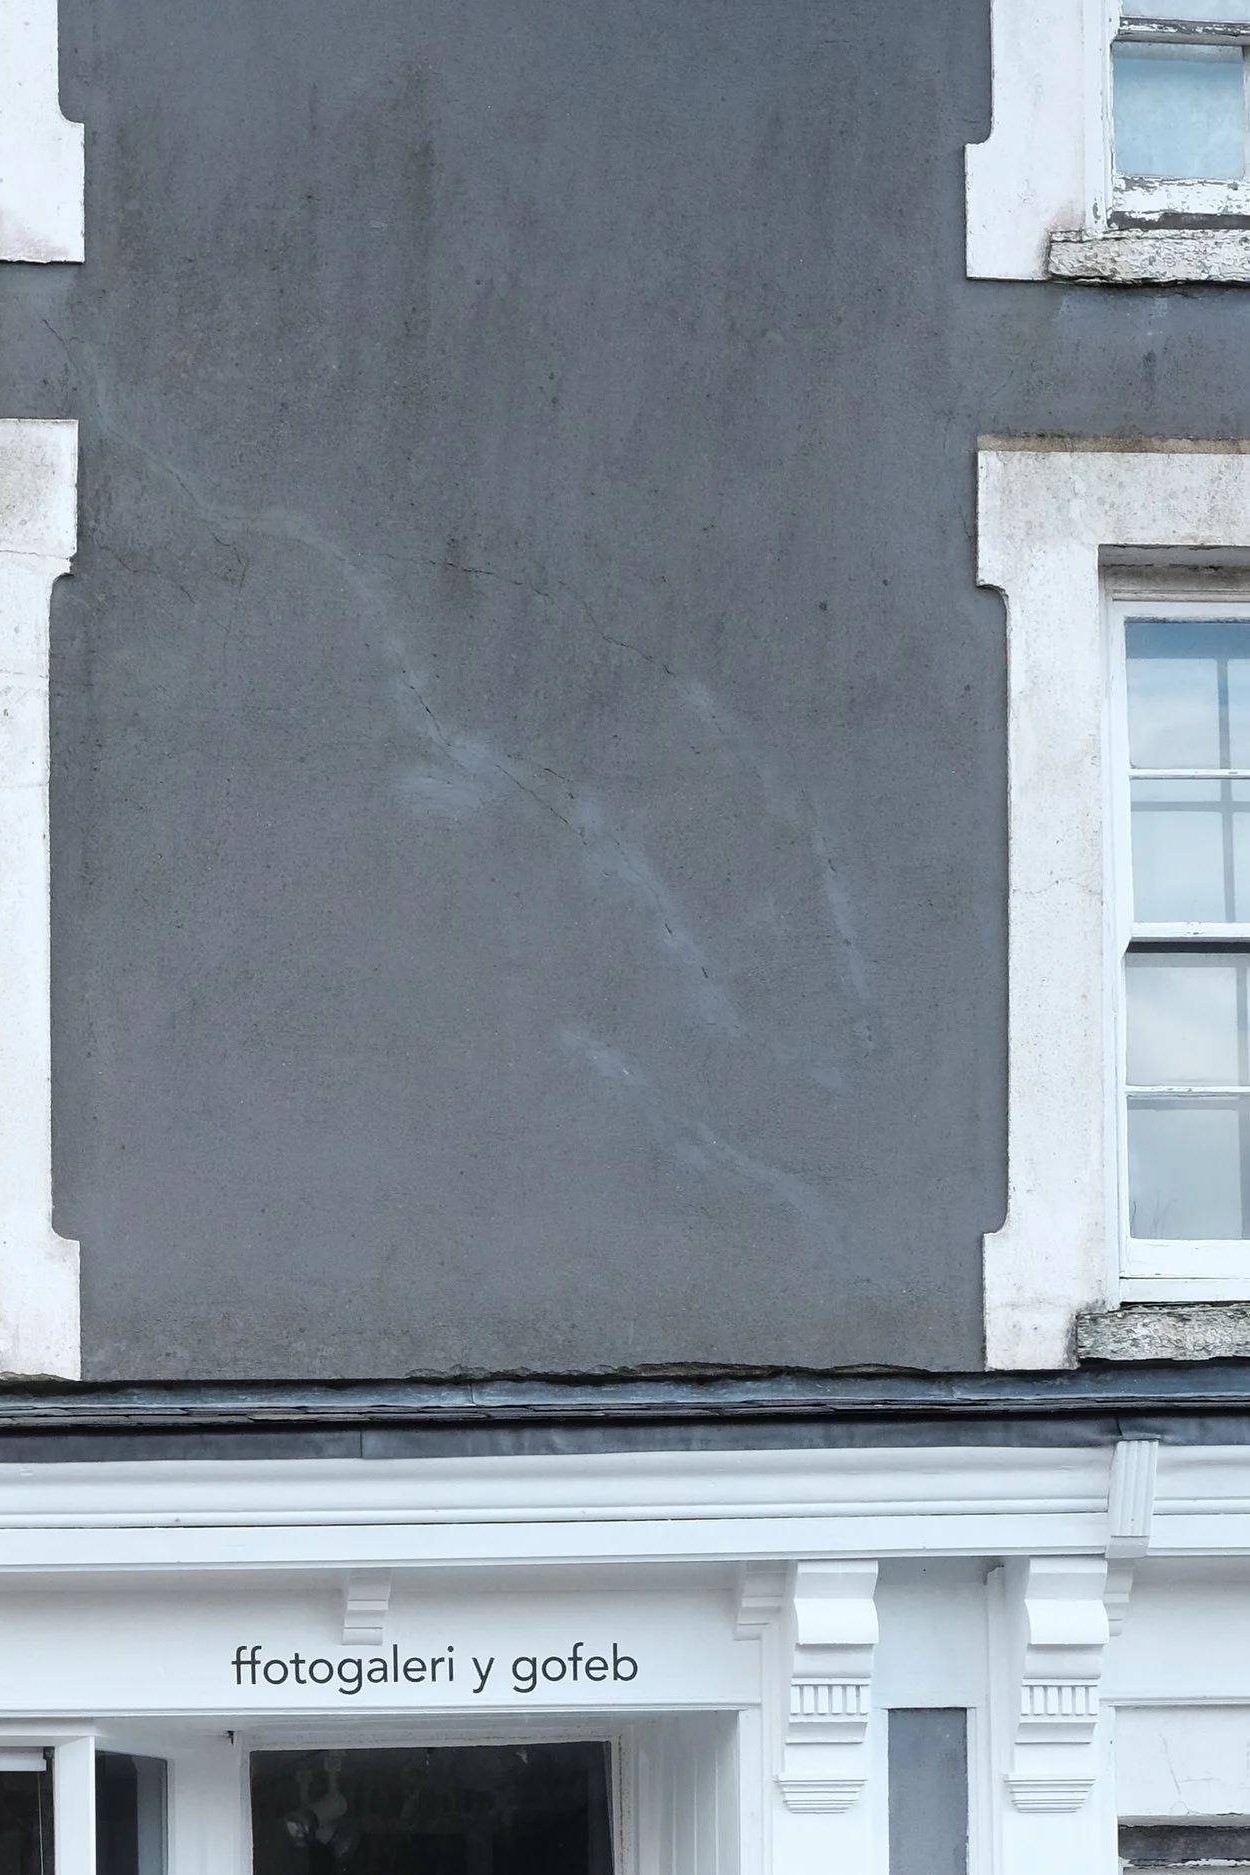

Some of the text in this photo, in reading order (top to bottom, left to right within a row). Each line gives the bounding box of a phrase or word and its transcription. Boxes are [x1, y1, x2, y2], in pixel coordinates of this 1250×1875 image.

[230, 1641, 639, 1696] ffotogaleri y gofeb
